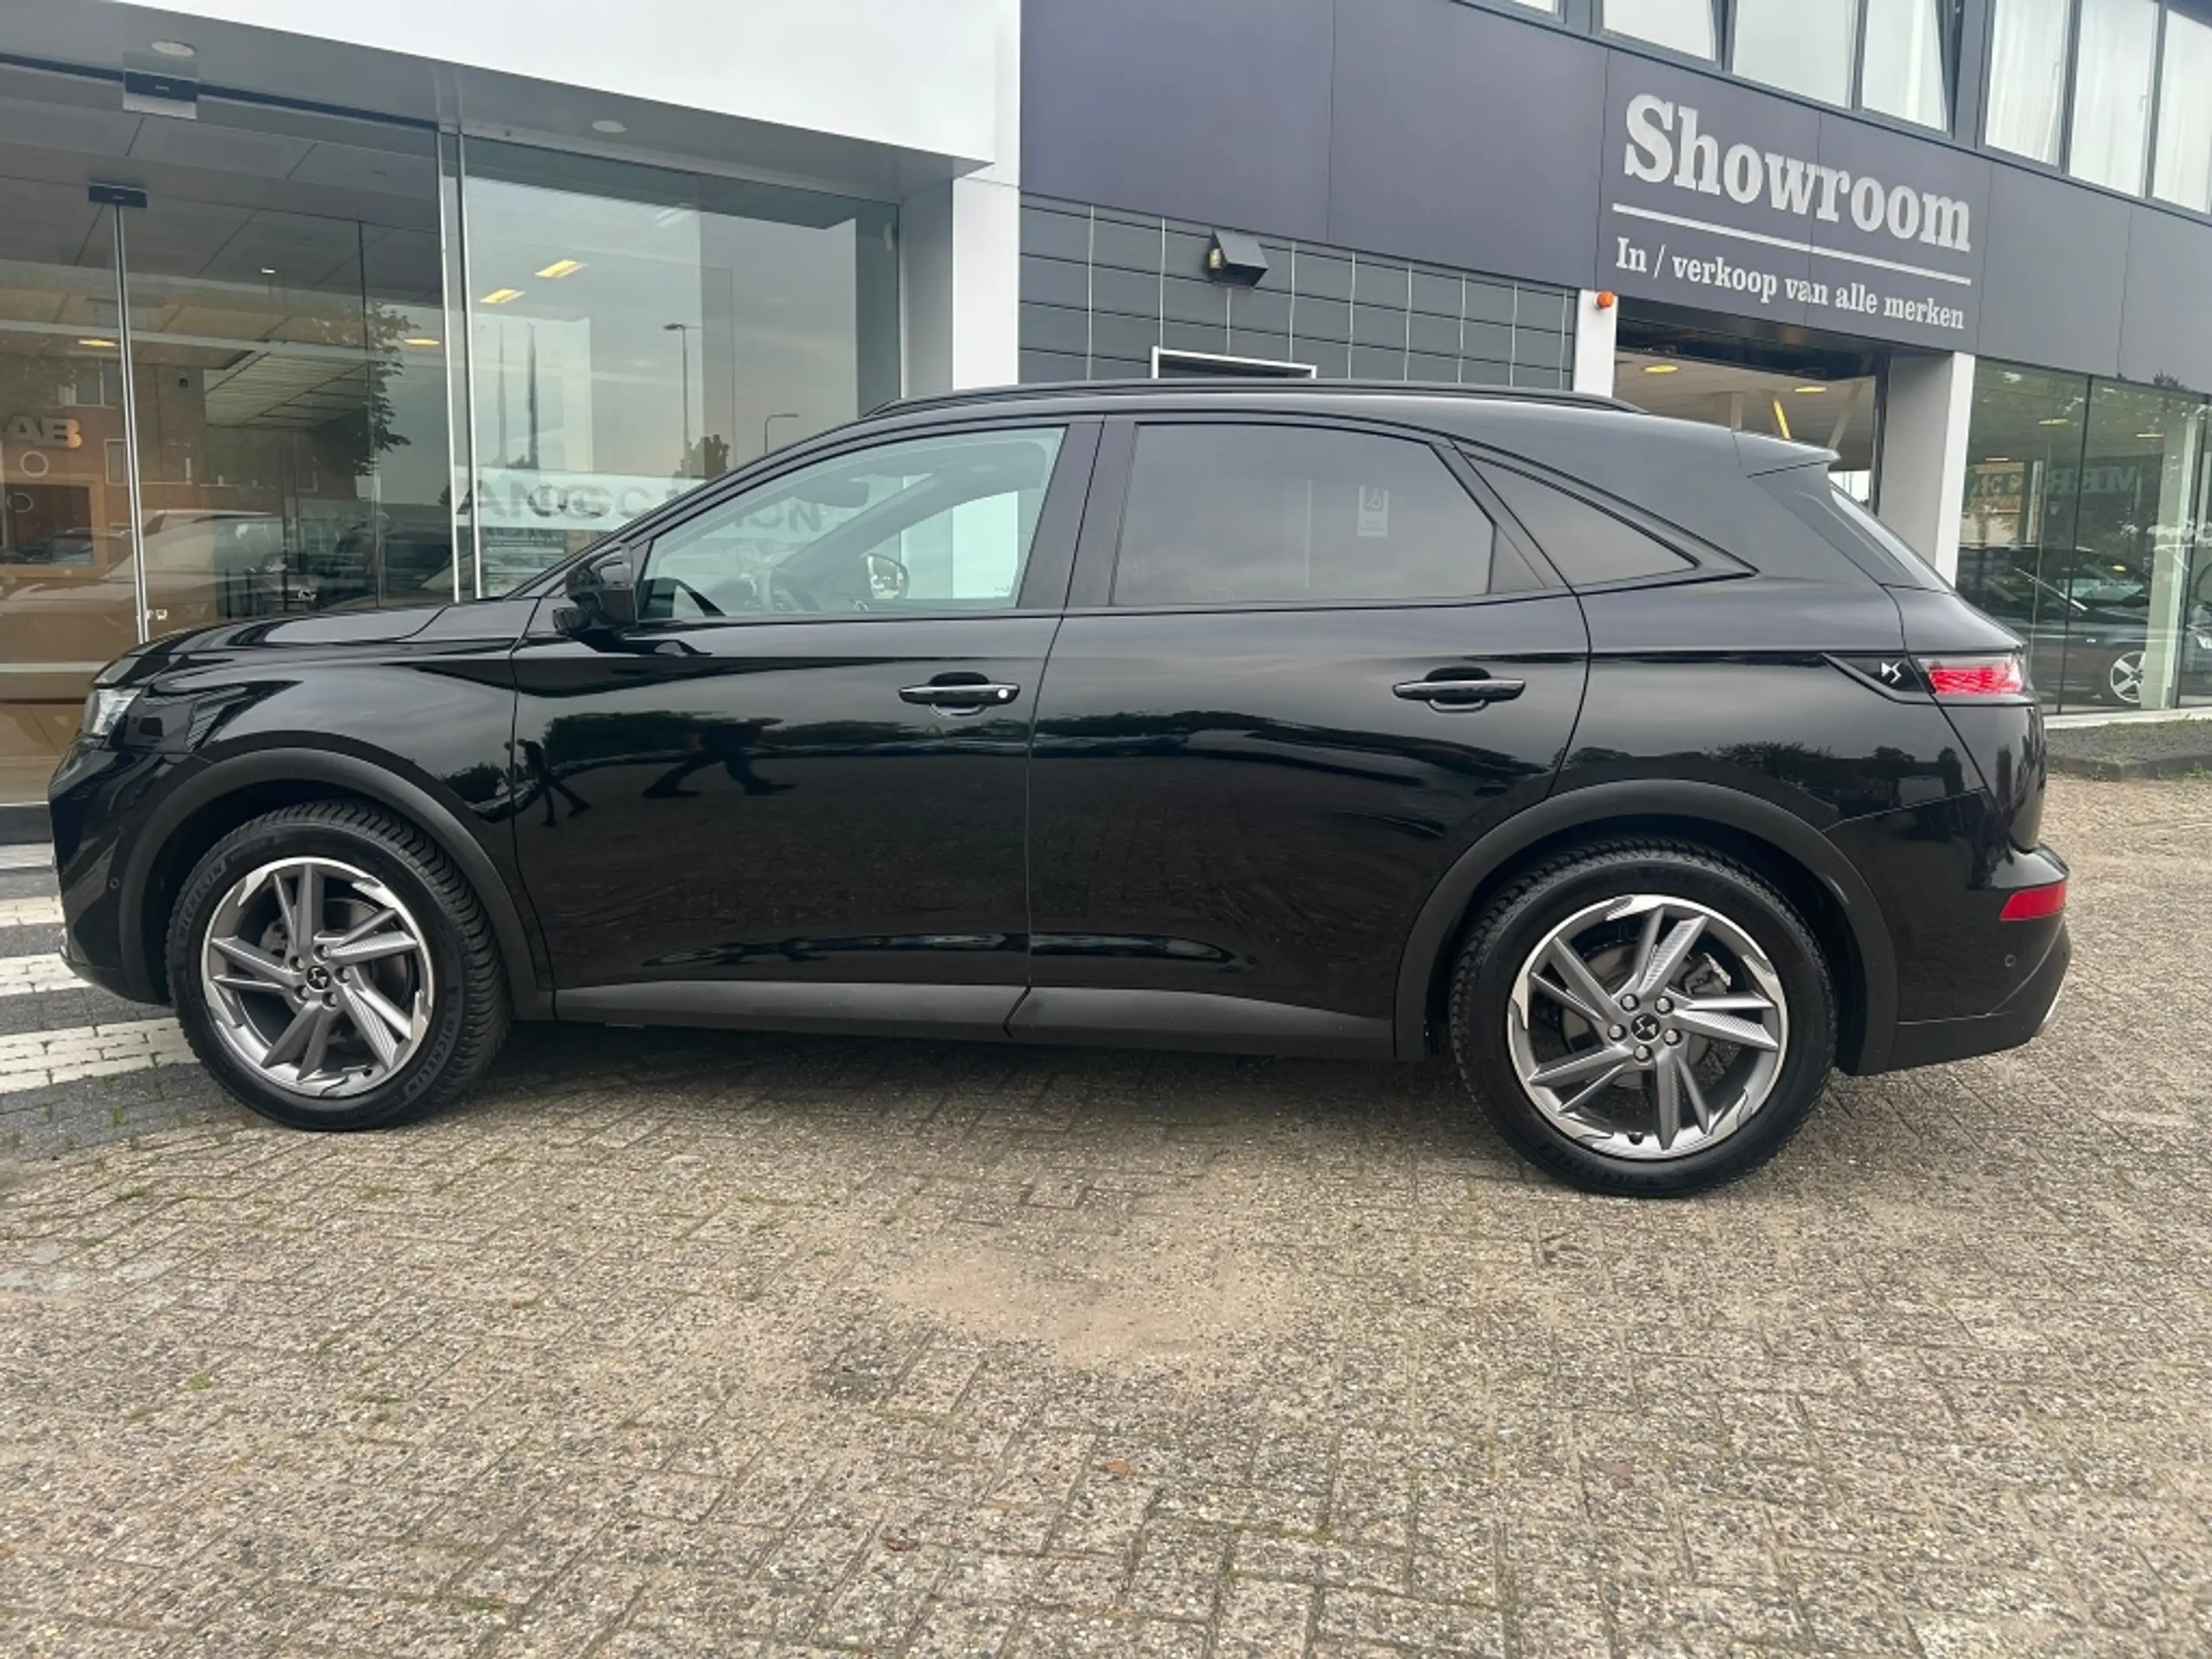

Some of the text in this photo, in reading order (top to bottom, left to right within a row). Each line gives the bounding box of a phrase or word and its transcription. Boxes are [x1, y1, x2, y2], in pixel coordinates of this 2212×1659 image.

[1624, 93, 1971, 252] Showroom
[1616, 237, 1647, 274] In
[1672, 256, 1777, 304] verkoop
[1785, 278, 1828, 306] van
[1836, 283, 1877, 315] alle
[1884, 296, 1964, 330] merken
